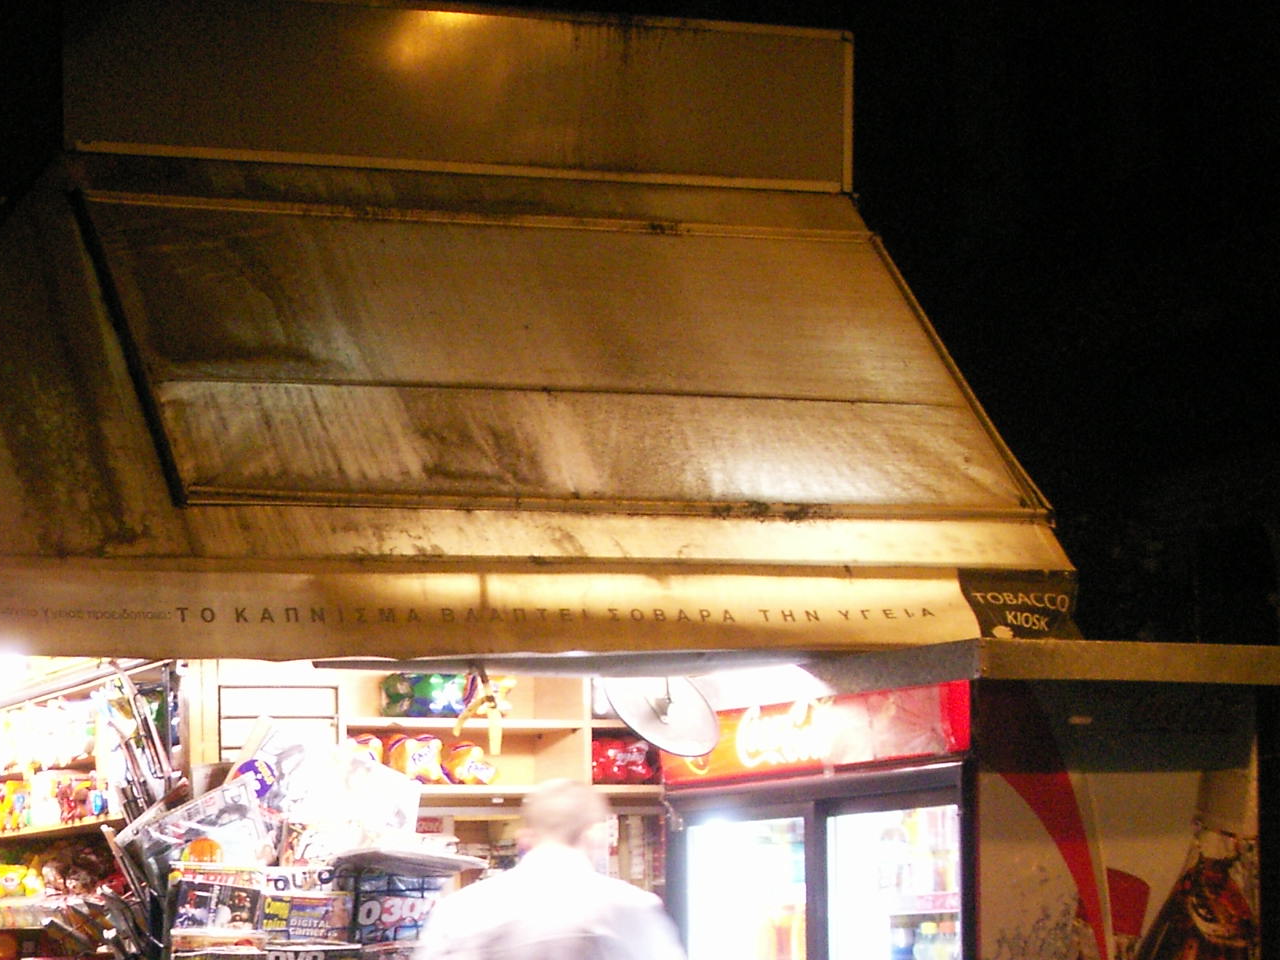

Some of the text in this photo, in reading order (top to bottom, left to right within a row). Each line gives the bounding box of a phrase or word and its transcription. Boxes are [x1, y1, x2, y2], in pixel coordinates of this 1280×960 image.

[971, 591, 1070, 612] TOBACCO
[176, 606, 215, 623] ΤΟ
[235, 606, 422, 624] ΚΑΠΝΙΣΜΑ
[608, 608, 736, 623] ΣΟΒΑΡΑ
[759, 608, 821, 623] ΤΗΝ
[838, 607, 936, 622] ΥΓΕΙΑ
[1006, 611, 1050, 631] KIOSK
[290, 918, 331, 929] DIGITAL
